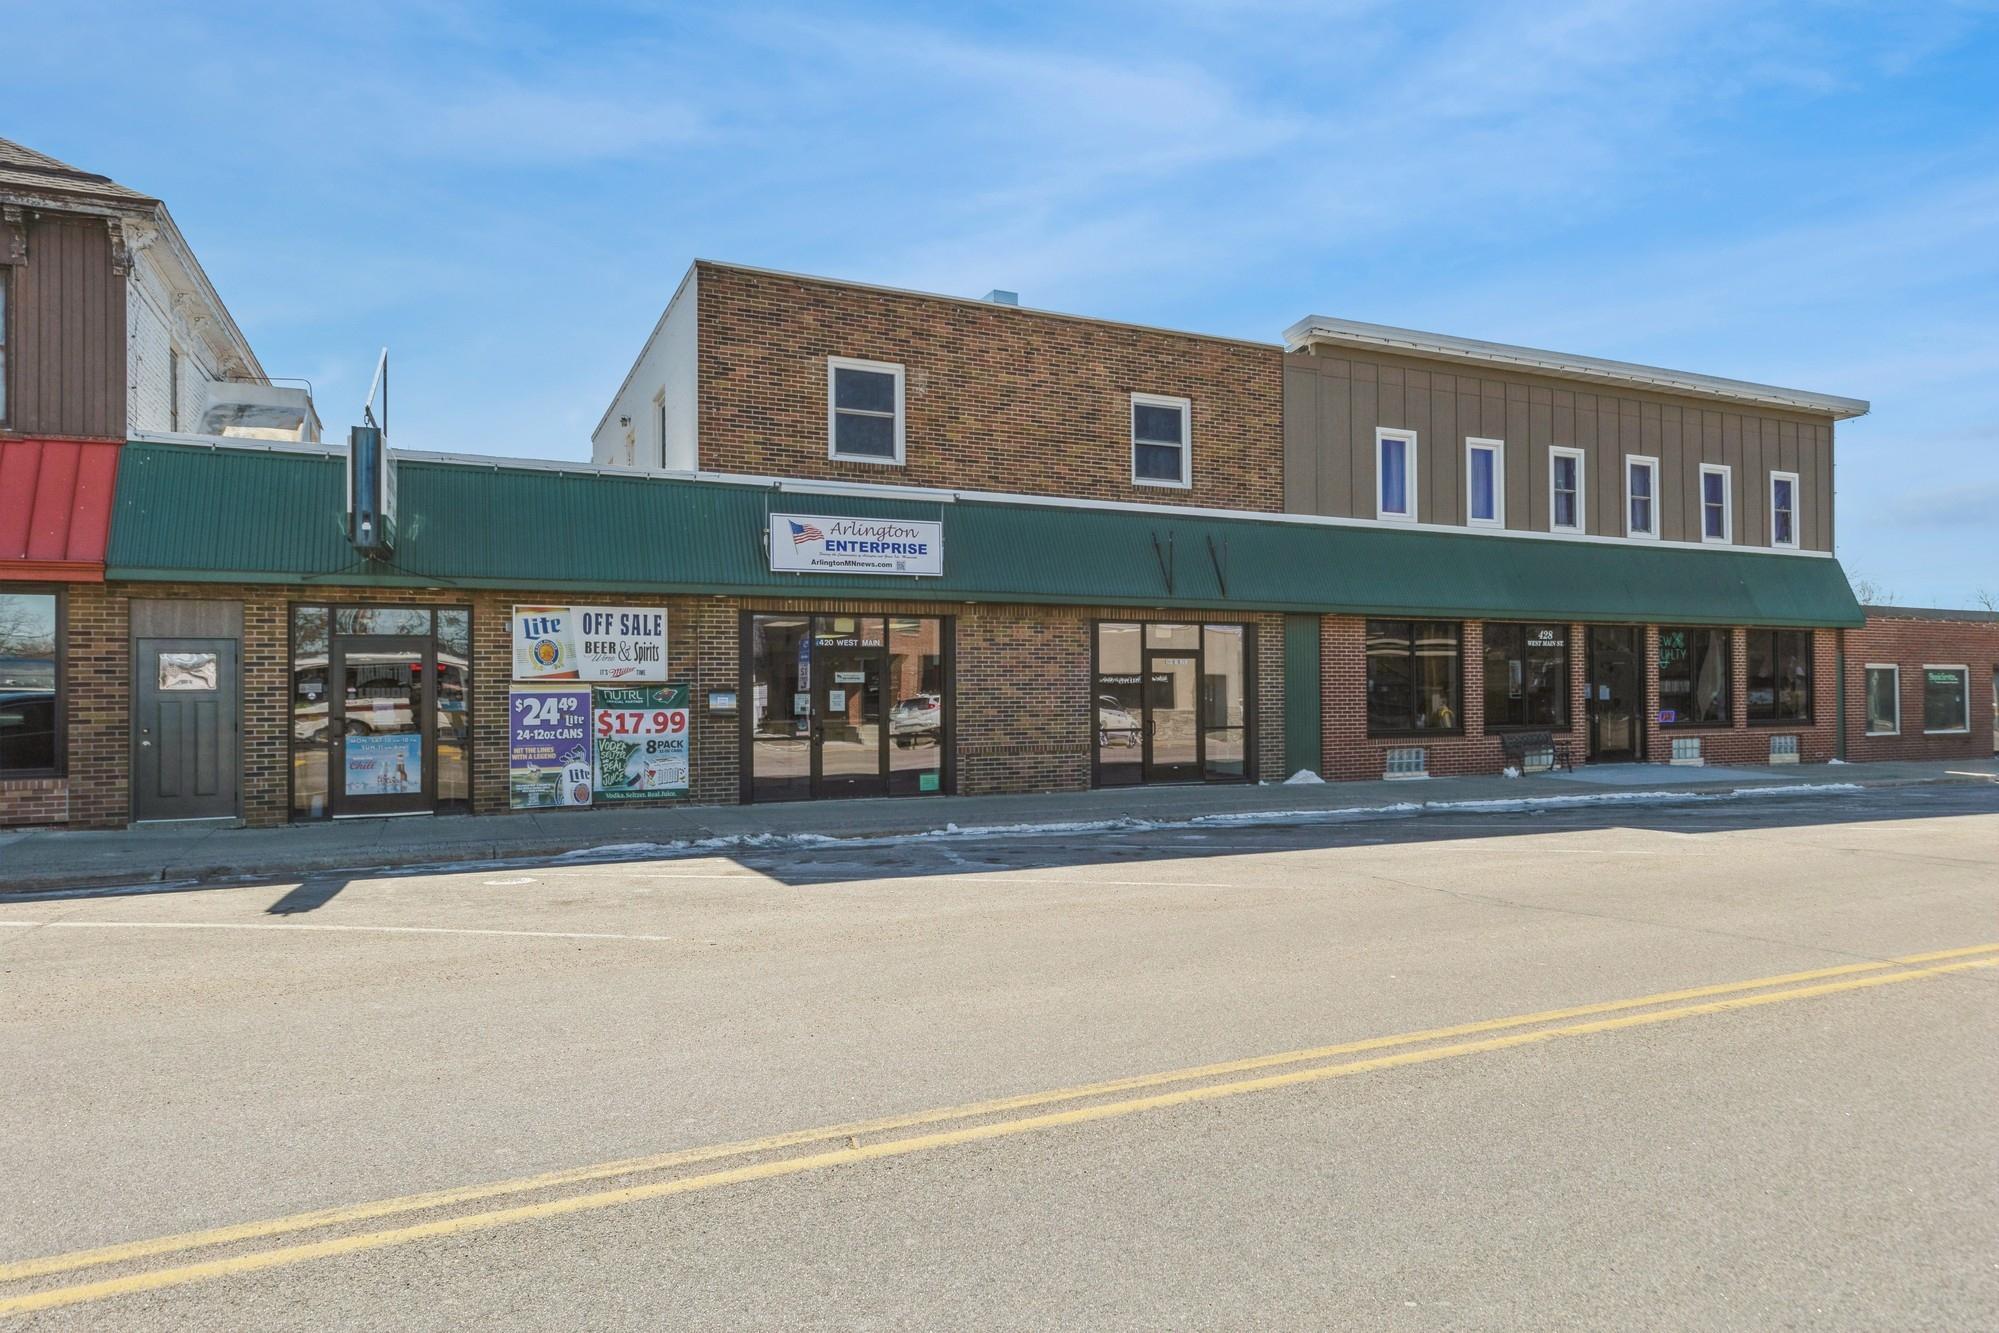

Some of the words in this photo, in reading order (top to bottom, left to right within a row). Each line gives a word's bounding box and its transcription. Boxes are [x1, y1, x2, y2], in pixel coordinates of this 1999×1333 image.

[830, 521, 919, 541] Arlington
[826, 540, 927, 555] ENTERPRISE
[811, 559, 892, 568] ArlingtonMNnews.com
[523, 617, 560, 640] Lite
[583, 612, 614, 635] OFF
[620, 613, 662, 636] SALE
[1538, 630, 1553, 640] 428
[819, 639, 834, 647] 420
[837, 639, 858, 647] WEST
[585, 641, 616, 654] BEER
[618, 641, 632, 662] &
[634, 642, 660, 664] Spirits
[565, 715, 584, 727] Lite
[598, 710, 686, 737] $17.99
[556, 728, 583, 739] CANS
[599, 739, 626, 751] VODKA
[646, 739, 657, 754] 8
[657, 740, 684, 749] PACK
[569, 769, 590, 783] Lite
[602, 771, 624, 785] JUICE
